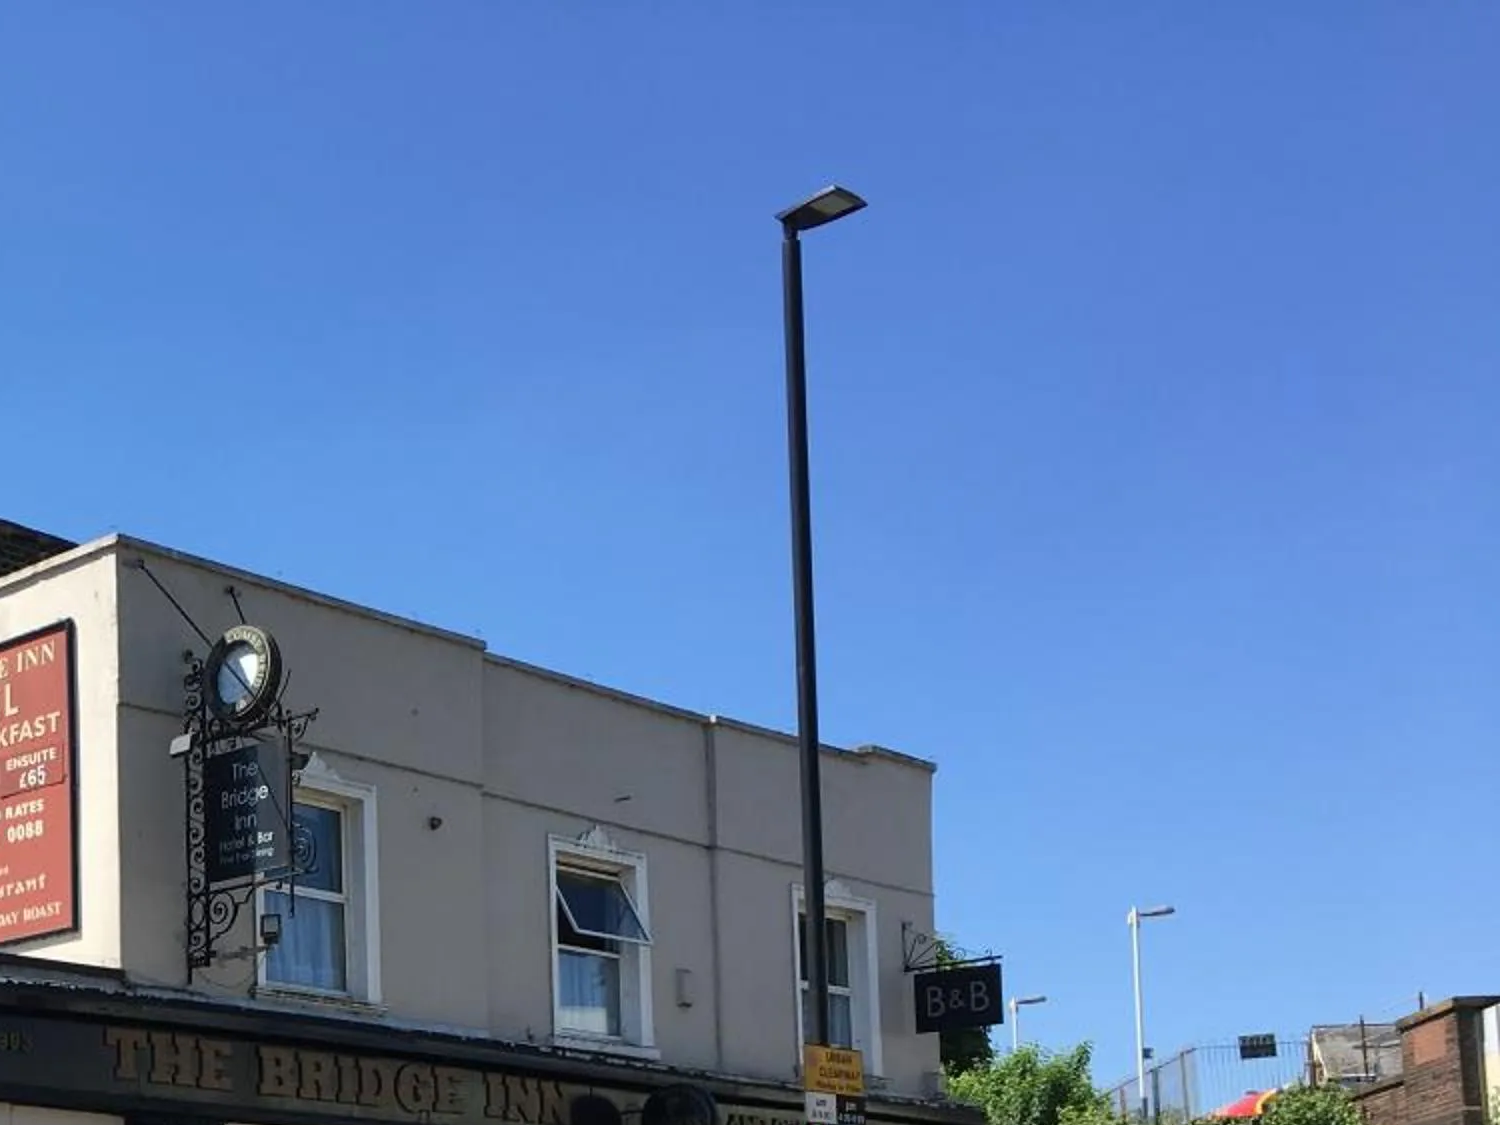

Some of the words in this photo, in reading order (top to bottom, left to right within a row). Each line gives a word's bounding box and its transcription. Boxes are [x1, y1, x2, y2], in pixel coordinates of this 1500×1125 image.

[16, 640, 55, 673] INN
[6, 748, 56, 771] ENSUITE
[19, 765, 46, 788] £65
[232, 761, 259, 782] The
[221, 785, 269, 809] Bridge
[5, 799, 44, 820] RATES
[7, 819, 44, 844] 0088
[23, 901, 62, 922] ROAST
[925, 981, 990, 1018] B&B
[103, 1025, 235, 1092] THE
[255, 1045, 471, 1120] BRIDGE
